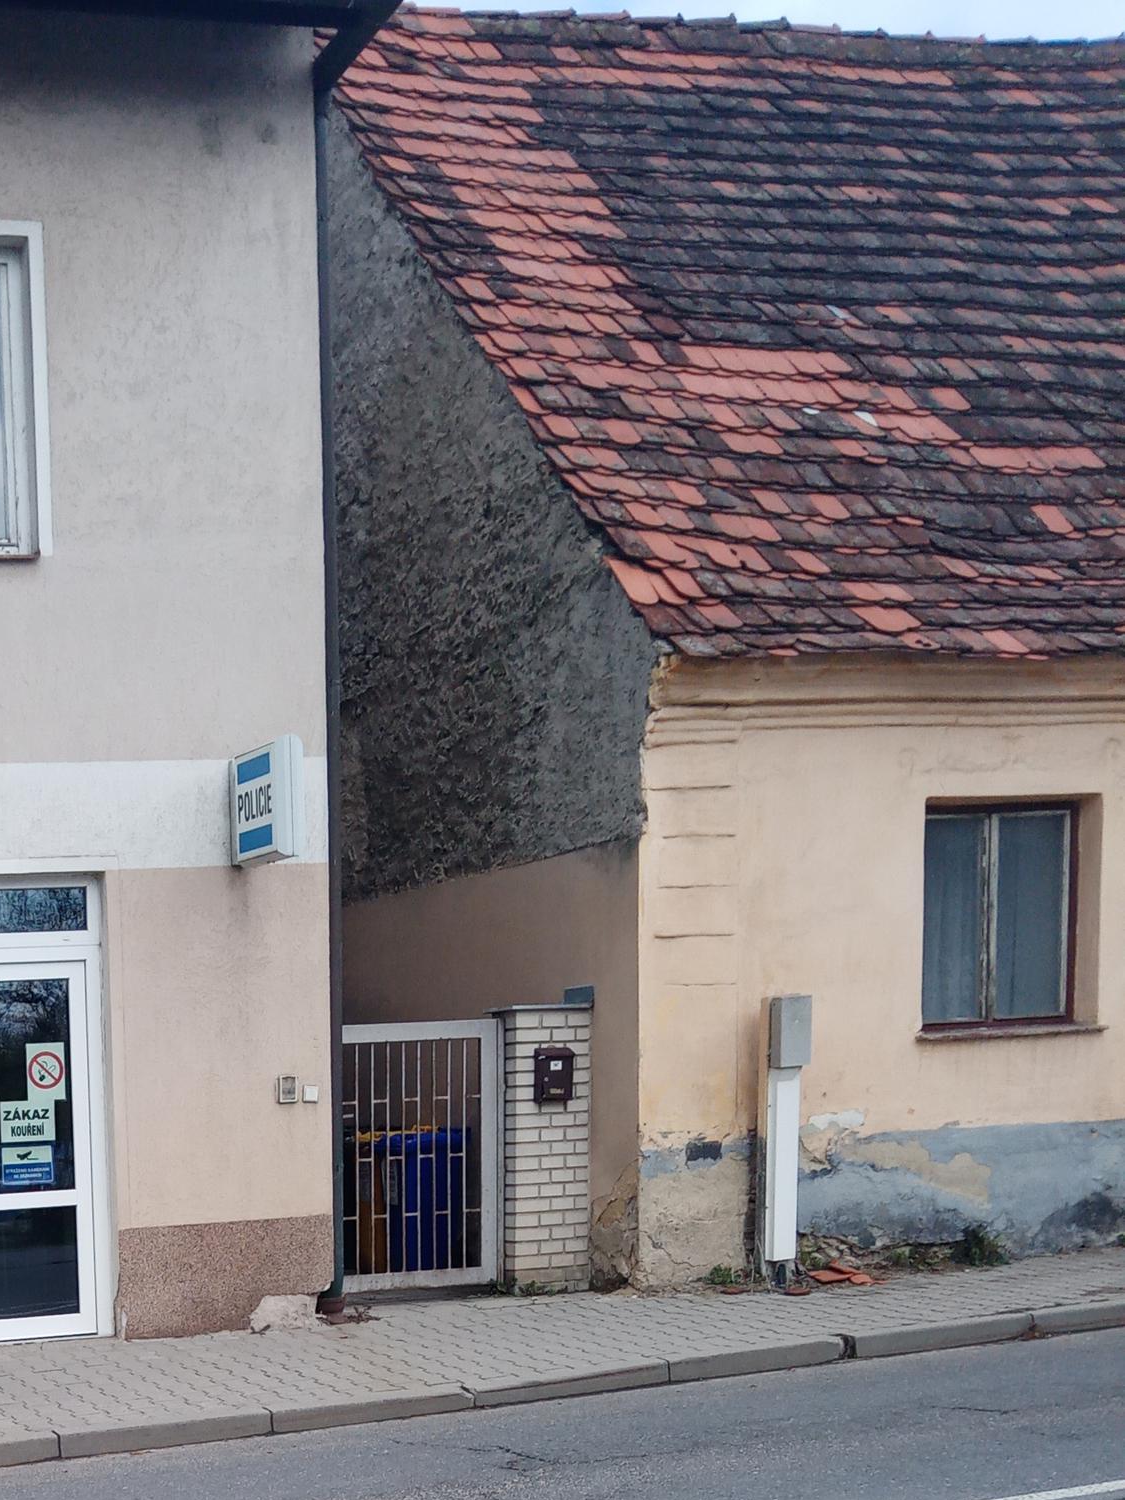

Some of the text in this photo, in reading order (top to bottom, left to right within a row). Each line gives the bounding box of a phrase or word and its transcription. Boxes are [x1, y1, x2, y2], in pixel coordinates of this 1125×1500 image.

[238, 784, 272, 824] POLICIE
[3, 1107, 50, 1121] ZÁKAZ
[11, 1122, 45, 1137] KOUŘENÍ
